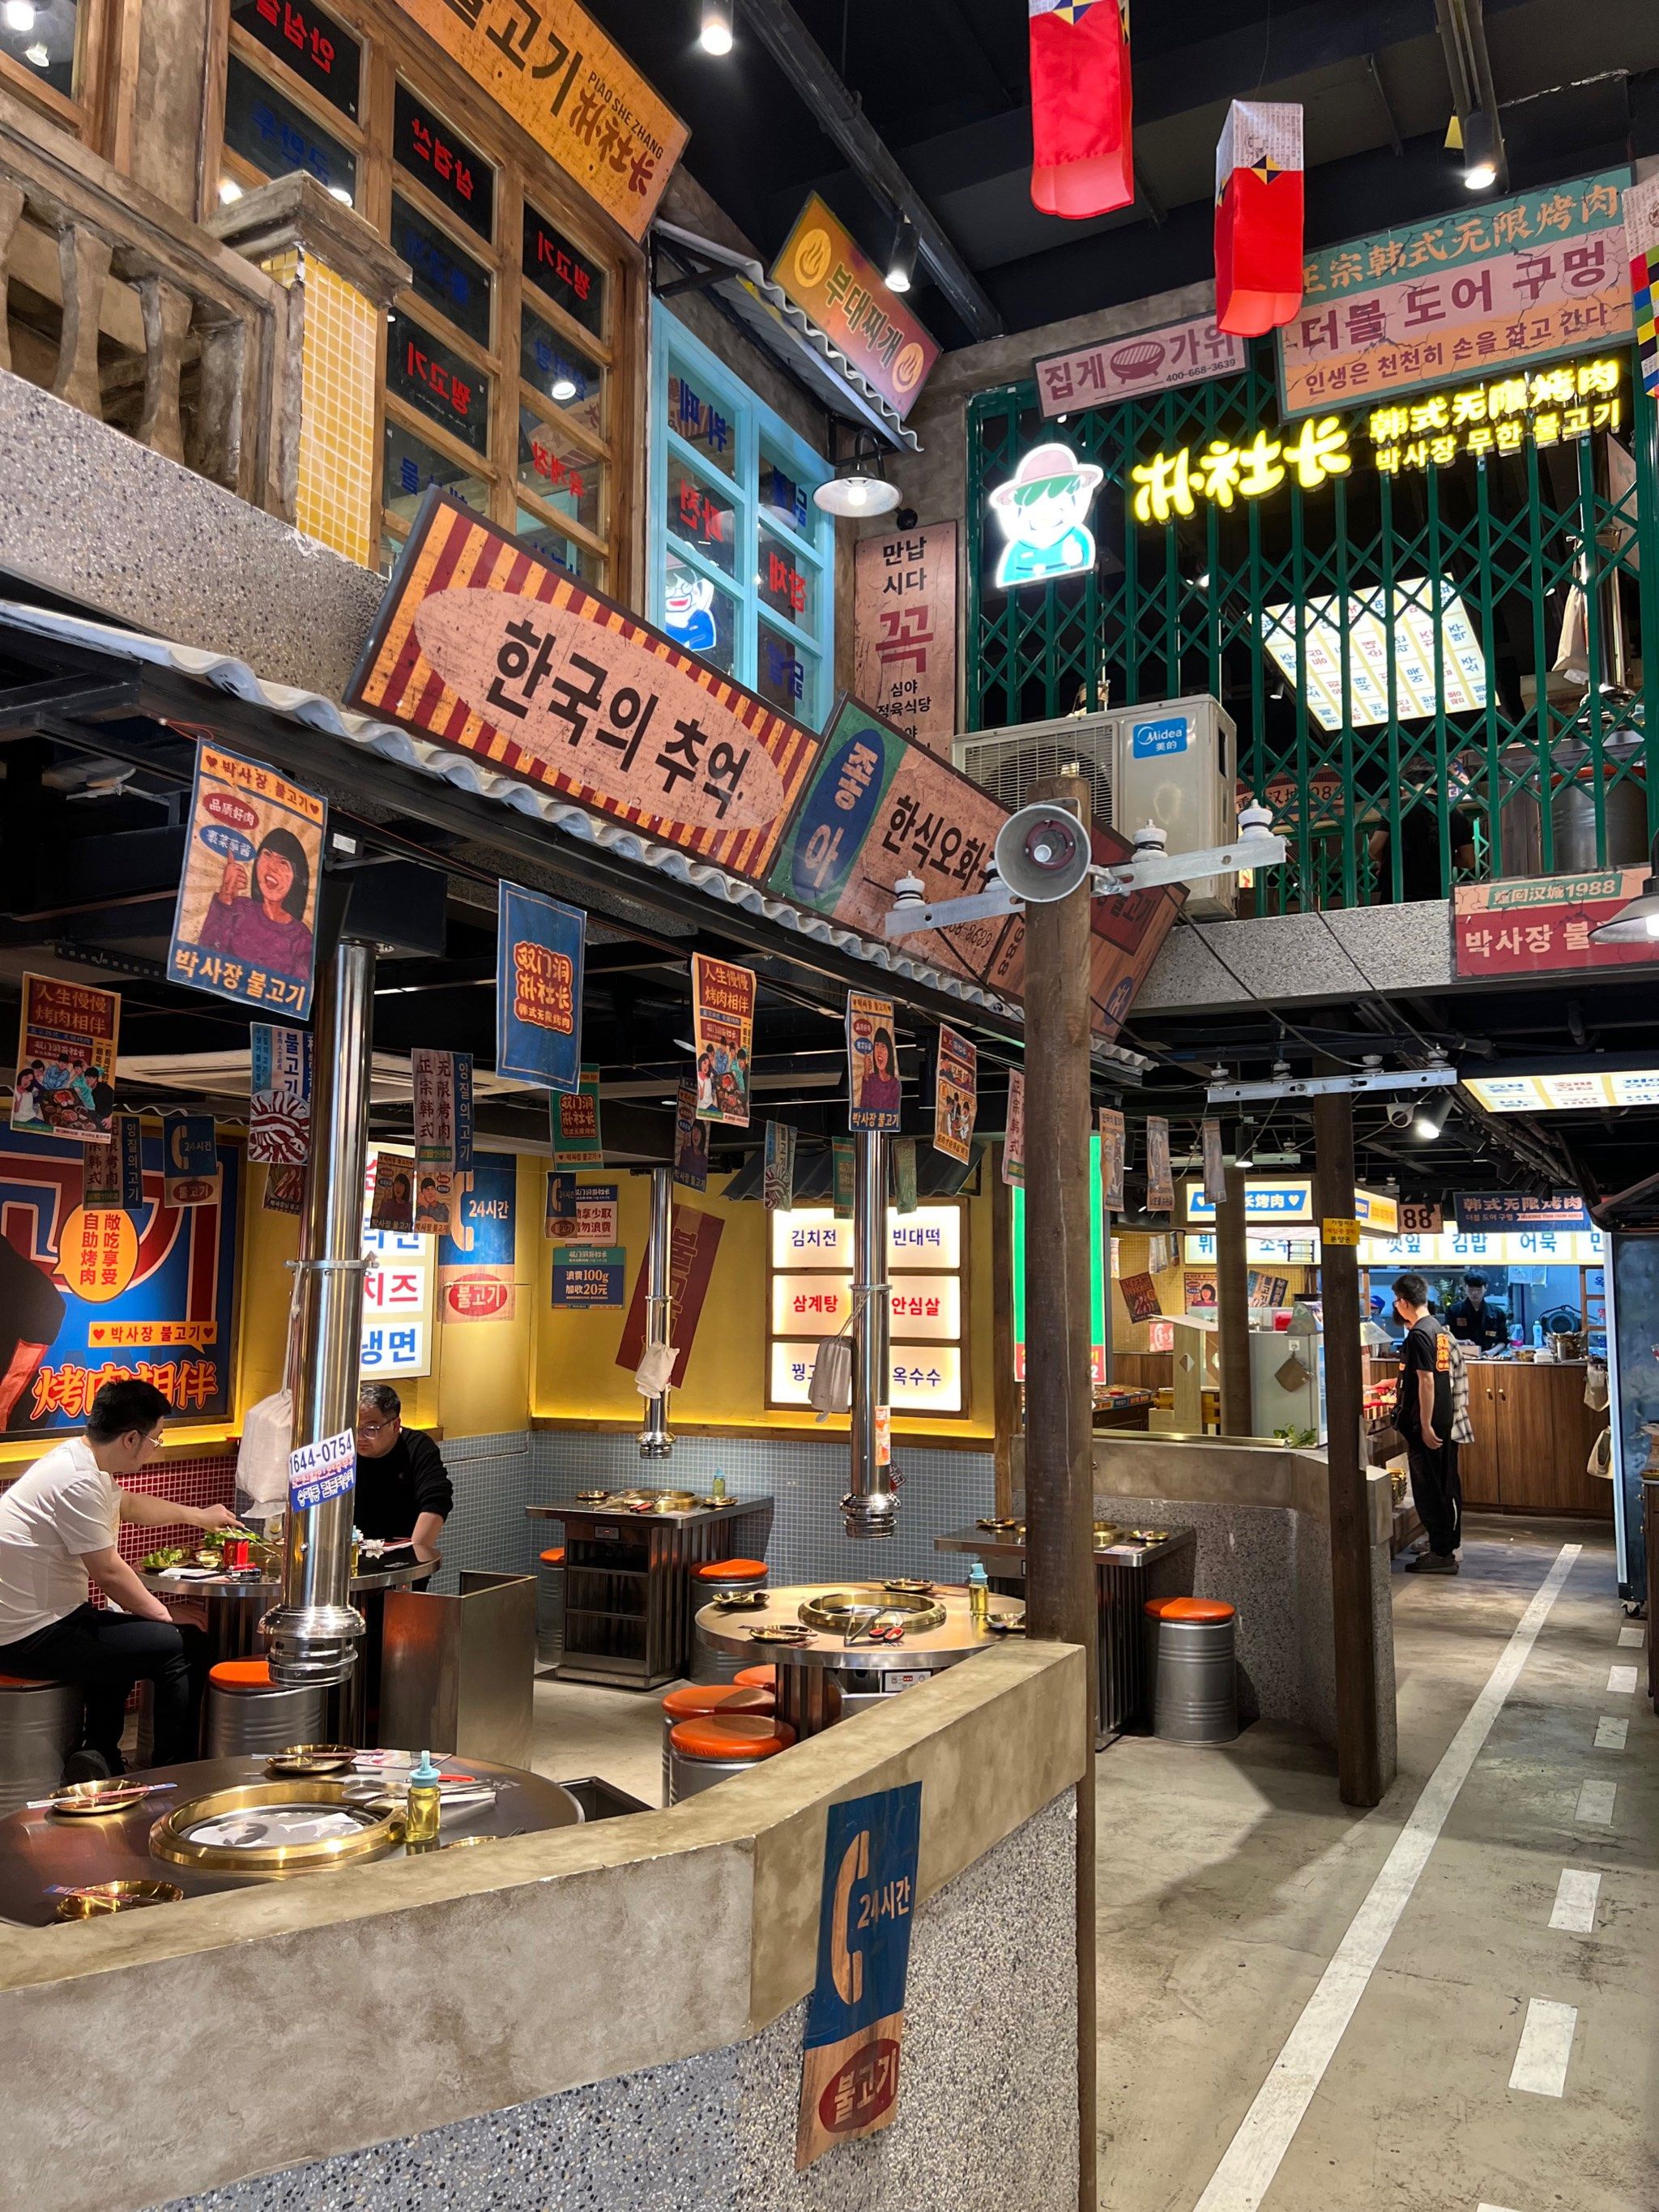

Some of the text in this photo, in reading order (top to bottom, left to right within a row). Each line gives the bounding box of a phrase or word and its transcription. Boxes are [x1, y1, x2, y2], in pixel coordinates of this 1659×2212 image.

[441, 0, 584, 117] 고기
[587, 70, 664, 160] PIAO SHE ZHANG
[1300, 240, 1607, 352] 더블 도어 구멍
[825, 262, 904, 369] 부대찌개
[1044, 326, 1235, 401] 집게 가위
[1306, 301, 1609, 396] 인생은 천천히 손을 잡고 간다
[1166, 357, 1236, 383] 400-668-3639
[1374, 398, 1621, 474] 박사장 무한 불고기
[882, 536, 927, 567] 만납
[882, 568, 928, 596] 시다
[875, 605, 934, 674] 꼭
[486, 619, 659, 772] 한국의
[891, 679, 919, 696] 심야
[877, 696, 932, 720] 정육식당
[1137, 725, 1183, 745] Midea
[1154, 740, 1178, 753] 美的
[222, 760, 310, 812] 박사장 불고기
[208, 797, 255, 827] 品质好肉
[1465, 924, 1554, 958] 박사장
[175, 948, 306, 1011] 박사장 불고기
[518, 946, 569, 984] 双门洞
[705, 963, 748, 992] 人生慢慢
[37, 983, 106, 1014] 人生慢慢
[705, 985, 748, 1014] 烤肉相伴
[35, 1005, 106, 1035] 烤肉相伴
[284, 1033, 299, 1094] 불고기
[417, 1059, 434, 1138] 正宗韩式
[437, 1061, 451, 1140] 无限烤肉
[852, 1112, 899, 1128] 박사장 불고기
[468, 1198, 510, 1219] 24시간
[80, 1214, 99, 1286] 自助烤肉
[100, 1214, 122, 1286] 敞吃享受
[791, 1228, 838, 1248] 김치전
[892, 1228, 940, 1247] 빈대떡
[1452, 1233, 1487, 1253] 김밥
[1520, 1233, 1557, 1253] 어묵
[457, 1283, 505, 1309] 불고기
[565, 1283, 608, 1295] 加收20元
[793, 1295, 838, 1314] 삼계탕
[891, 1296, 940, 1317] 안심살
[111, 1325, 200, 1343] 박사장 불고기
[360, 1328, 416, 1364] 냉면
[892, 1365, 941, 1388] 옥수수
[290, 1433, 352, 1475] 1644-0754
[858, 1876, 911, 1930] 24시간
[834, 2048, 897, 2124] 불고기
